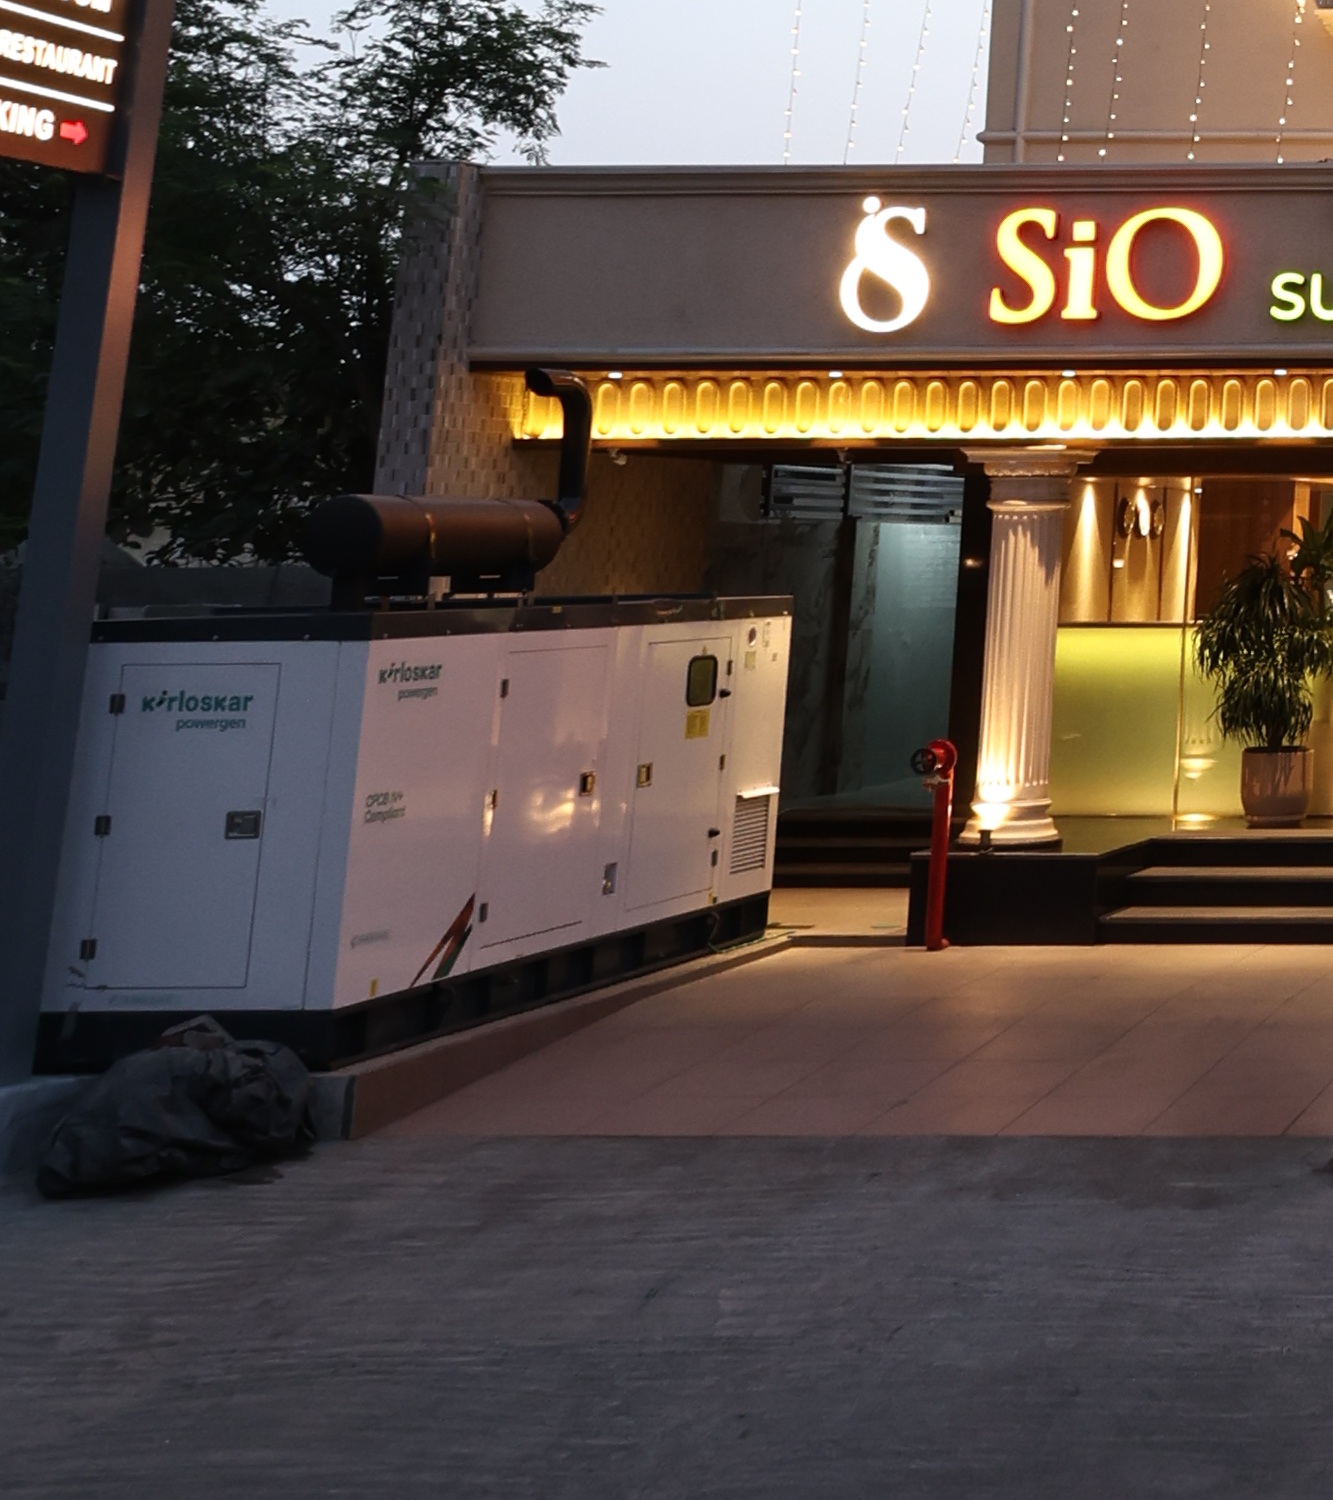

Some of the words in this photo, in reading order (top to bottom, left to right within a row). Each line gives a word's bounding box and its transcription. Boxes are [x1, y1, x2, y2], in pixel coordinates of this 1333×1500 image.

[0, 29, 118, 85] RESTAURANT
[988, 206, 1224, 324] SiO
[176, 718, 246, 732] powergen
